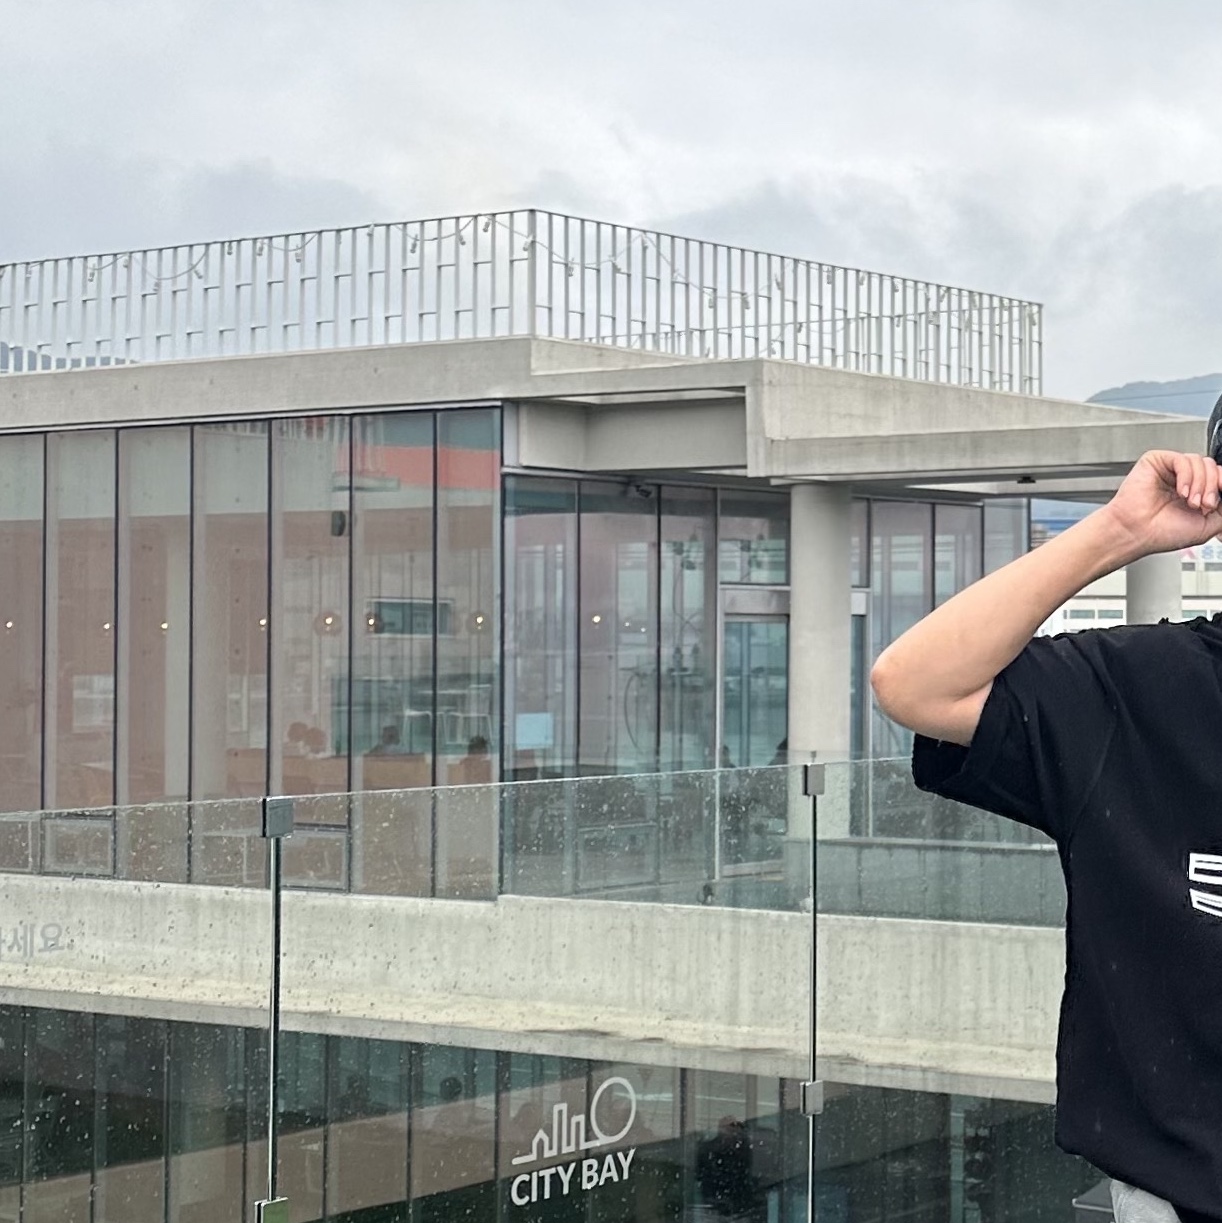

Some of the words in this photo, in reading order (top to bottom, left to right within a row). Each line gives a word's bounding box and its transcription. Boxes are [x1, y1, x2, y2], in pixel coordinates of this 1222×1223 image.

[0, 923, 65, 961] 세요
[510, 1162, 576, 1207] CITY
[581, 1147, 637, 1191] BAY
